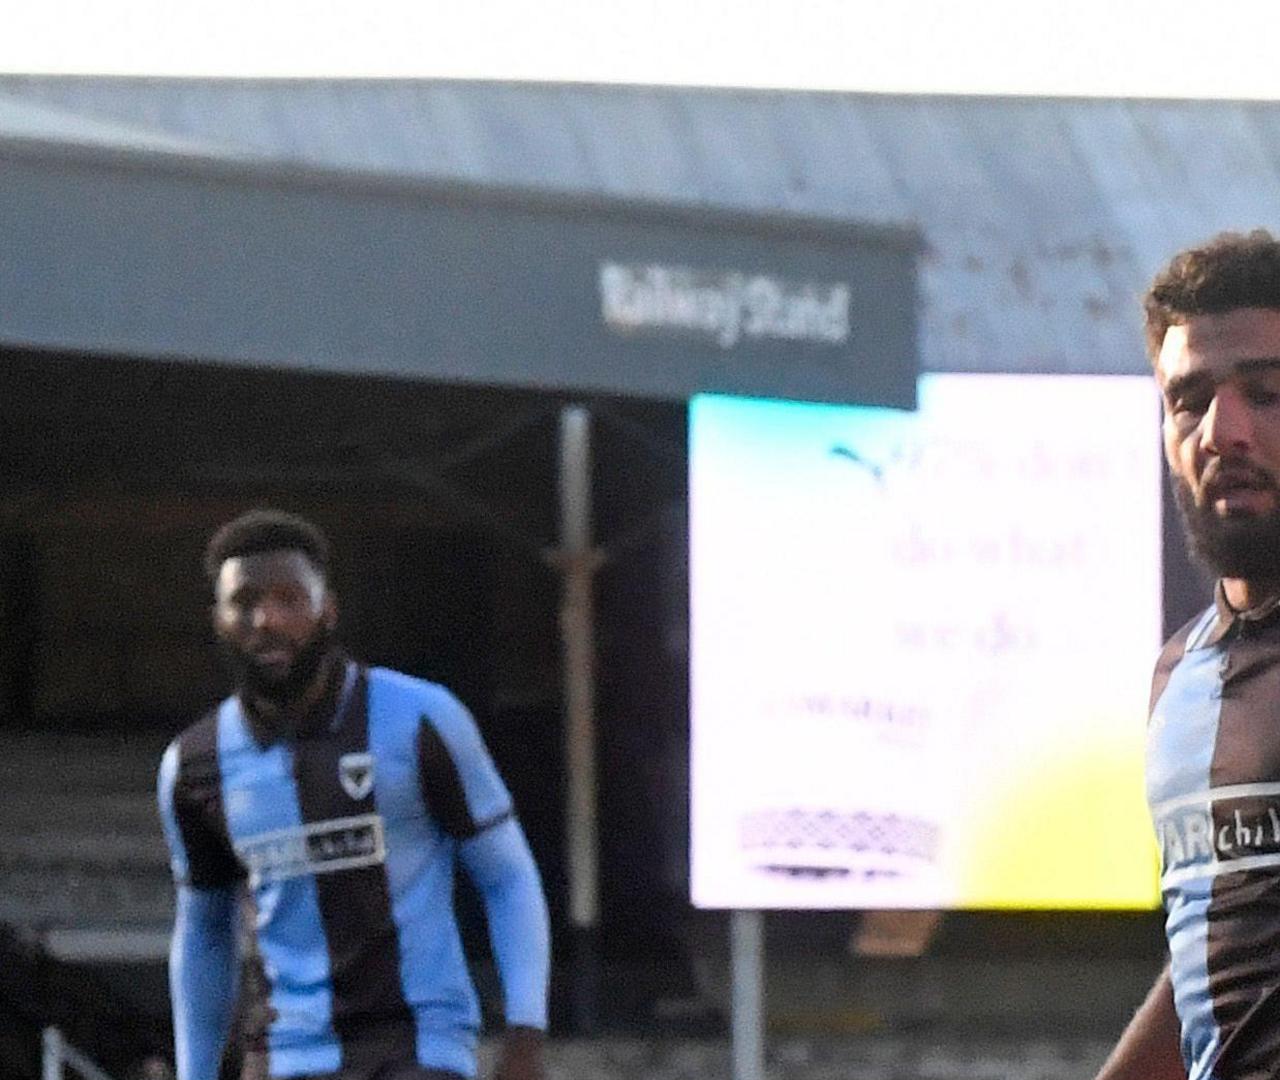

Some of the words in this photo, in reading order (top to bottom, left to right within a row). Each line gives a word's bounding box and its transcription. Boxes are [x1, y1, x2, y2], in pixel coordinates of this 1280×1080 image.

[600, 262, 742, 350] Railway
[746, 274, 850, 344] Stand
[1155, 812, 1213, 863] AR
